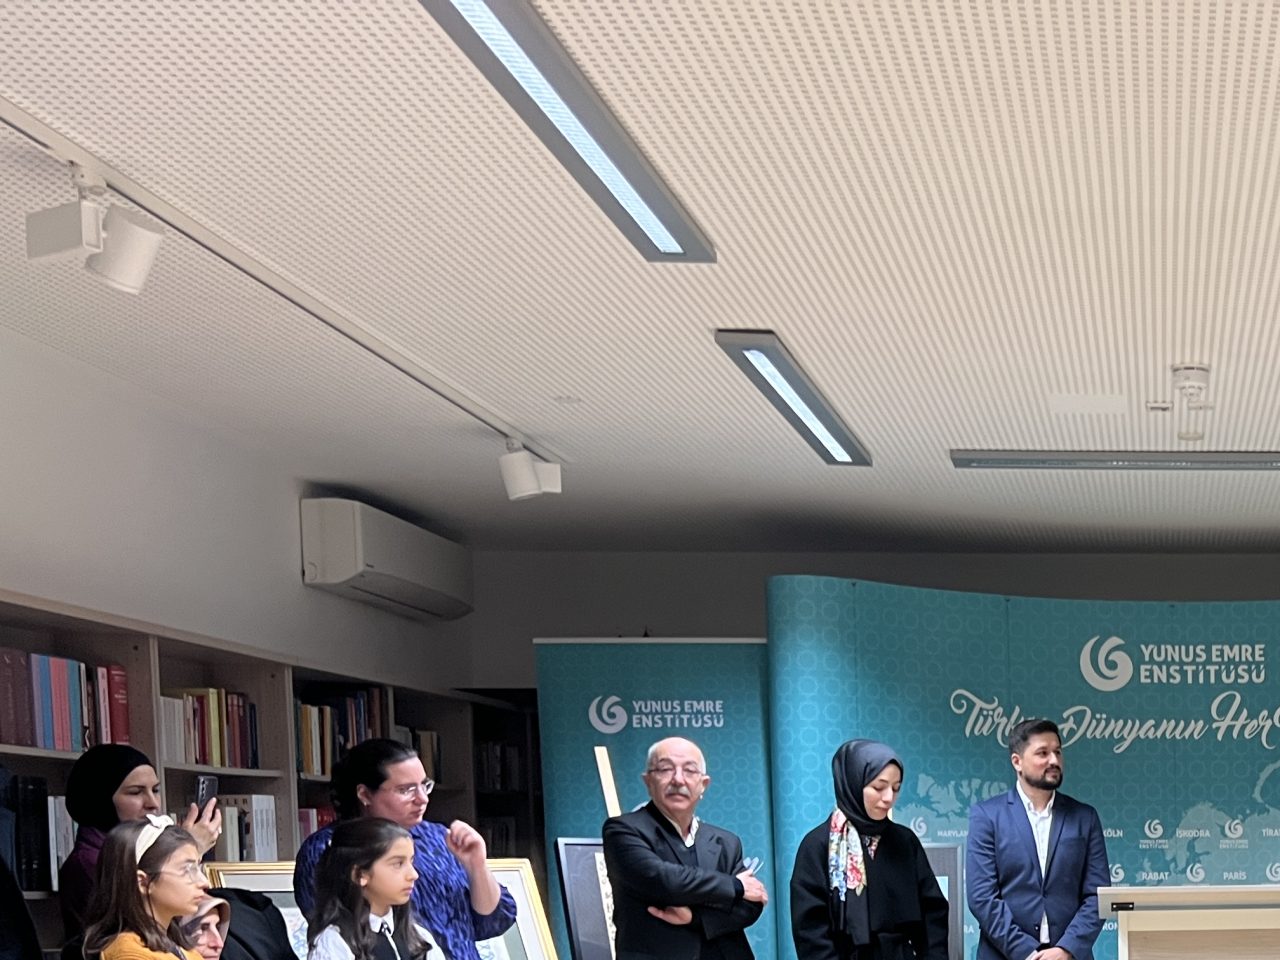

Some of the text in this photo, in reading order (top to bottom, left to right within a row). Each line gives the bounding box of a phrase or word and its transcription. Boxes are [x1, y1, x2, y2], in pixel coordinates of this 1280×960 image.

[1140, 644, 1266, 662] YUNUS EMRE
[1140, 664, 1266, 684] ENSTİTÜSÜ
[632, 700, 724, 713] YUNUS EMRE
[632, 714, 724, 728] ENSTİTÜSÜ
[950, 689, 1049, 748] Türk
[1057, 705, 1208, 754] Dünyanın
[1210, 691, 1276, 750] Her
[1142, 871, 1170, 881] RABAT
